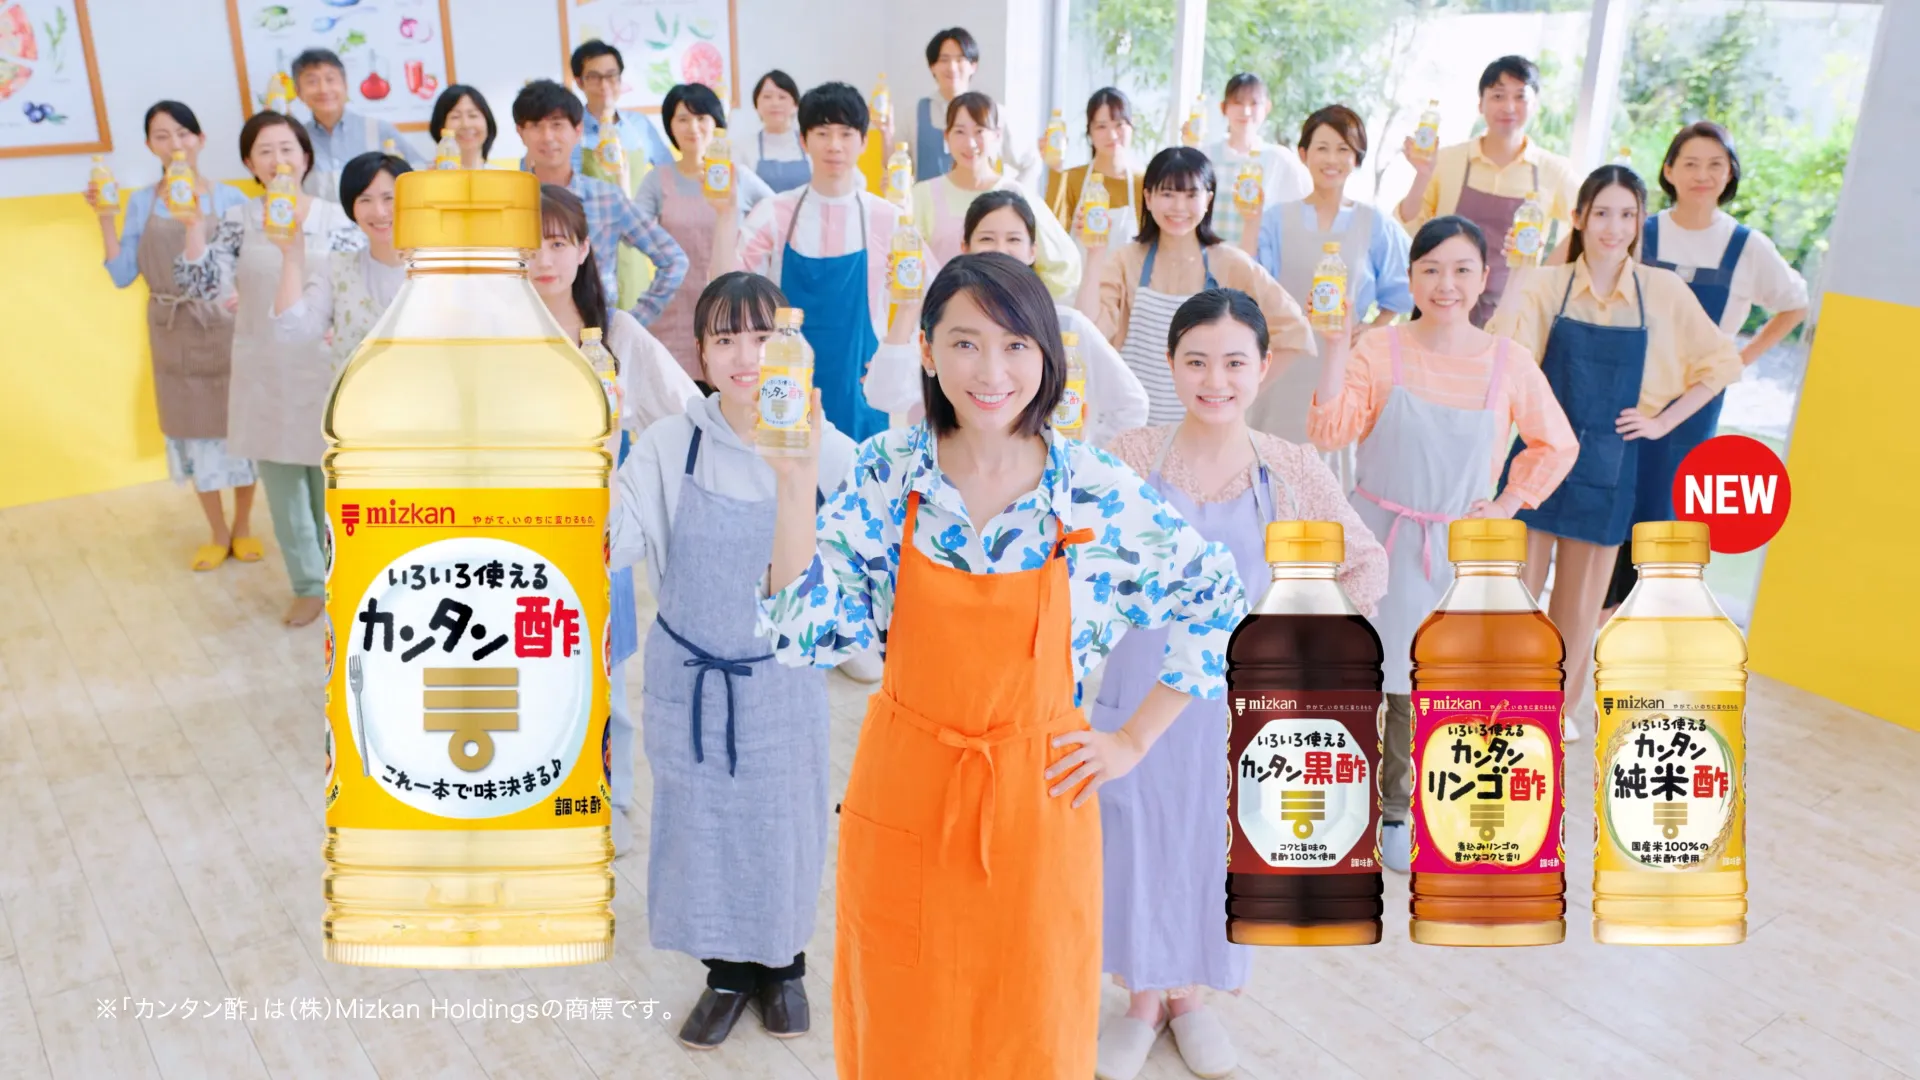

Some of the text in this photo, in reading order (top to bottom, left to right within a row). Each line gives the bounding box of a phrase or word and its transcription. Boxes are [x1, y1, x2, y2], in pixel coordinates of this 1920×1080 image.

[366, 499, 455, 525] mizkan
[388, 560, 548, 590] いろいろ使える
[359, 597, 580, 663] カンタン酢
[1249, 695, 1297, 710] mizkan
[1433, 695, 1482, 710] mizkan
[1617, 695, 1664, 709] mizkan
[1448, 724, 1524, 737] いろいろ使える
[1631, 719, 1707, 731] いろいろ使える
[1257, 731, 1346, 748] いろいろ使える
[1635, 731, 1707, 762] カンタン
[1451, 737, 1524, 768] カンタン
[1241, 751, 1367, 785] カンタン黒酢
[1428, 766, 1546, 801] リンゴ酢
[1614, 762, 1729, 801] 純米酢
[555, 795, 601, 816] 調味酢
[1279, 843, 1328, 852] コクと旨味の
[1457, 841, 1520, 851] 煮込みリンゴの
[1631, 841, 1709, 852] 国産米100%の
[1270, 853, 1337, 862] 黒酢100%使用
[1454, 851, 1521, 862] 豊かなコクと香り
[1640, 853, 1700, 863] 純米酢使用
